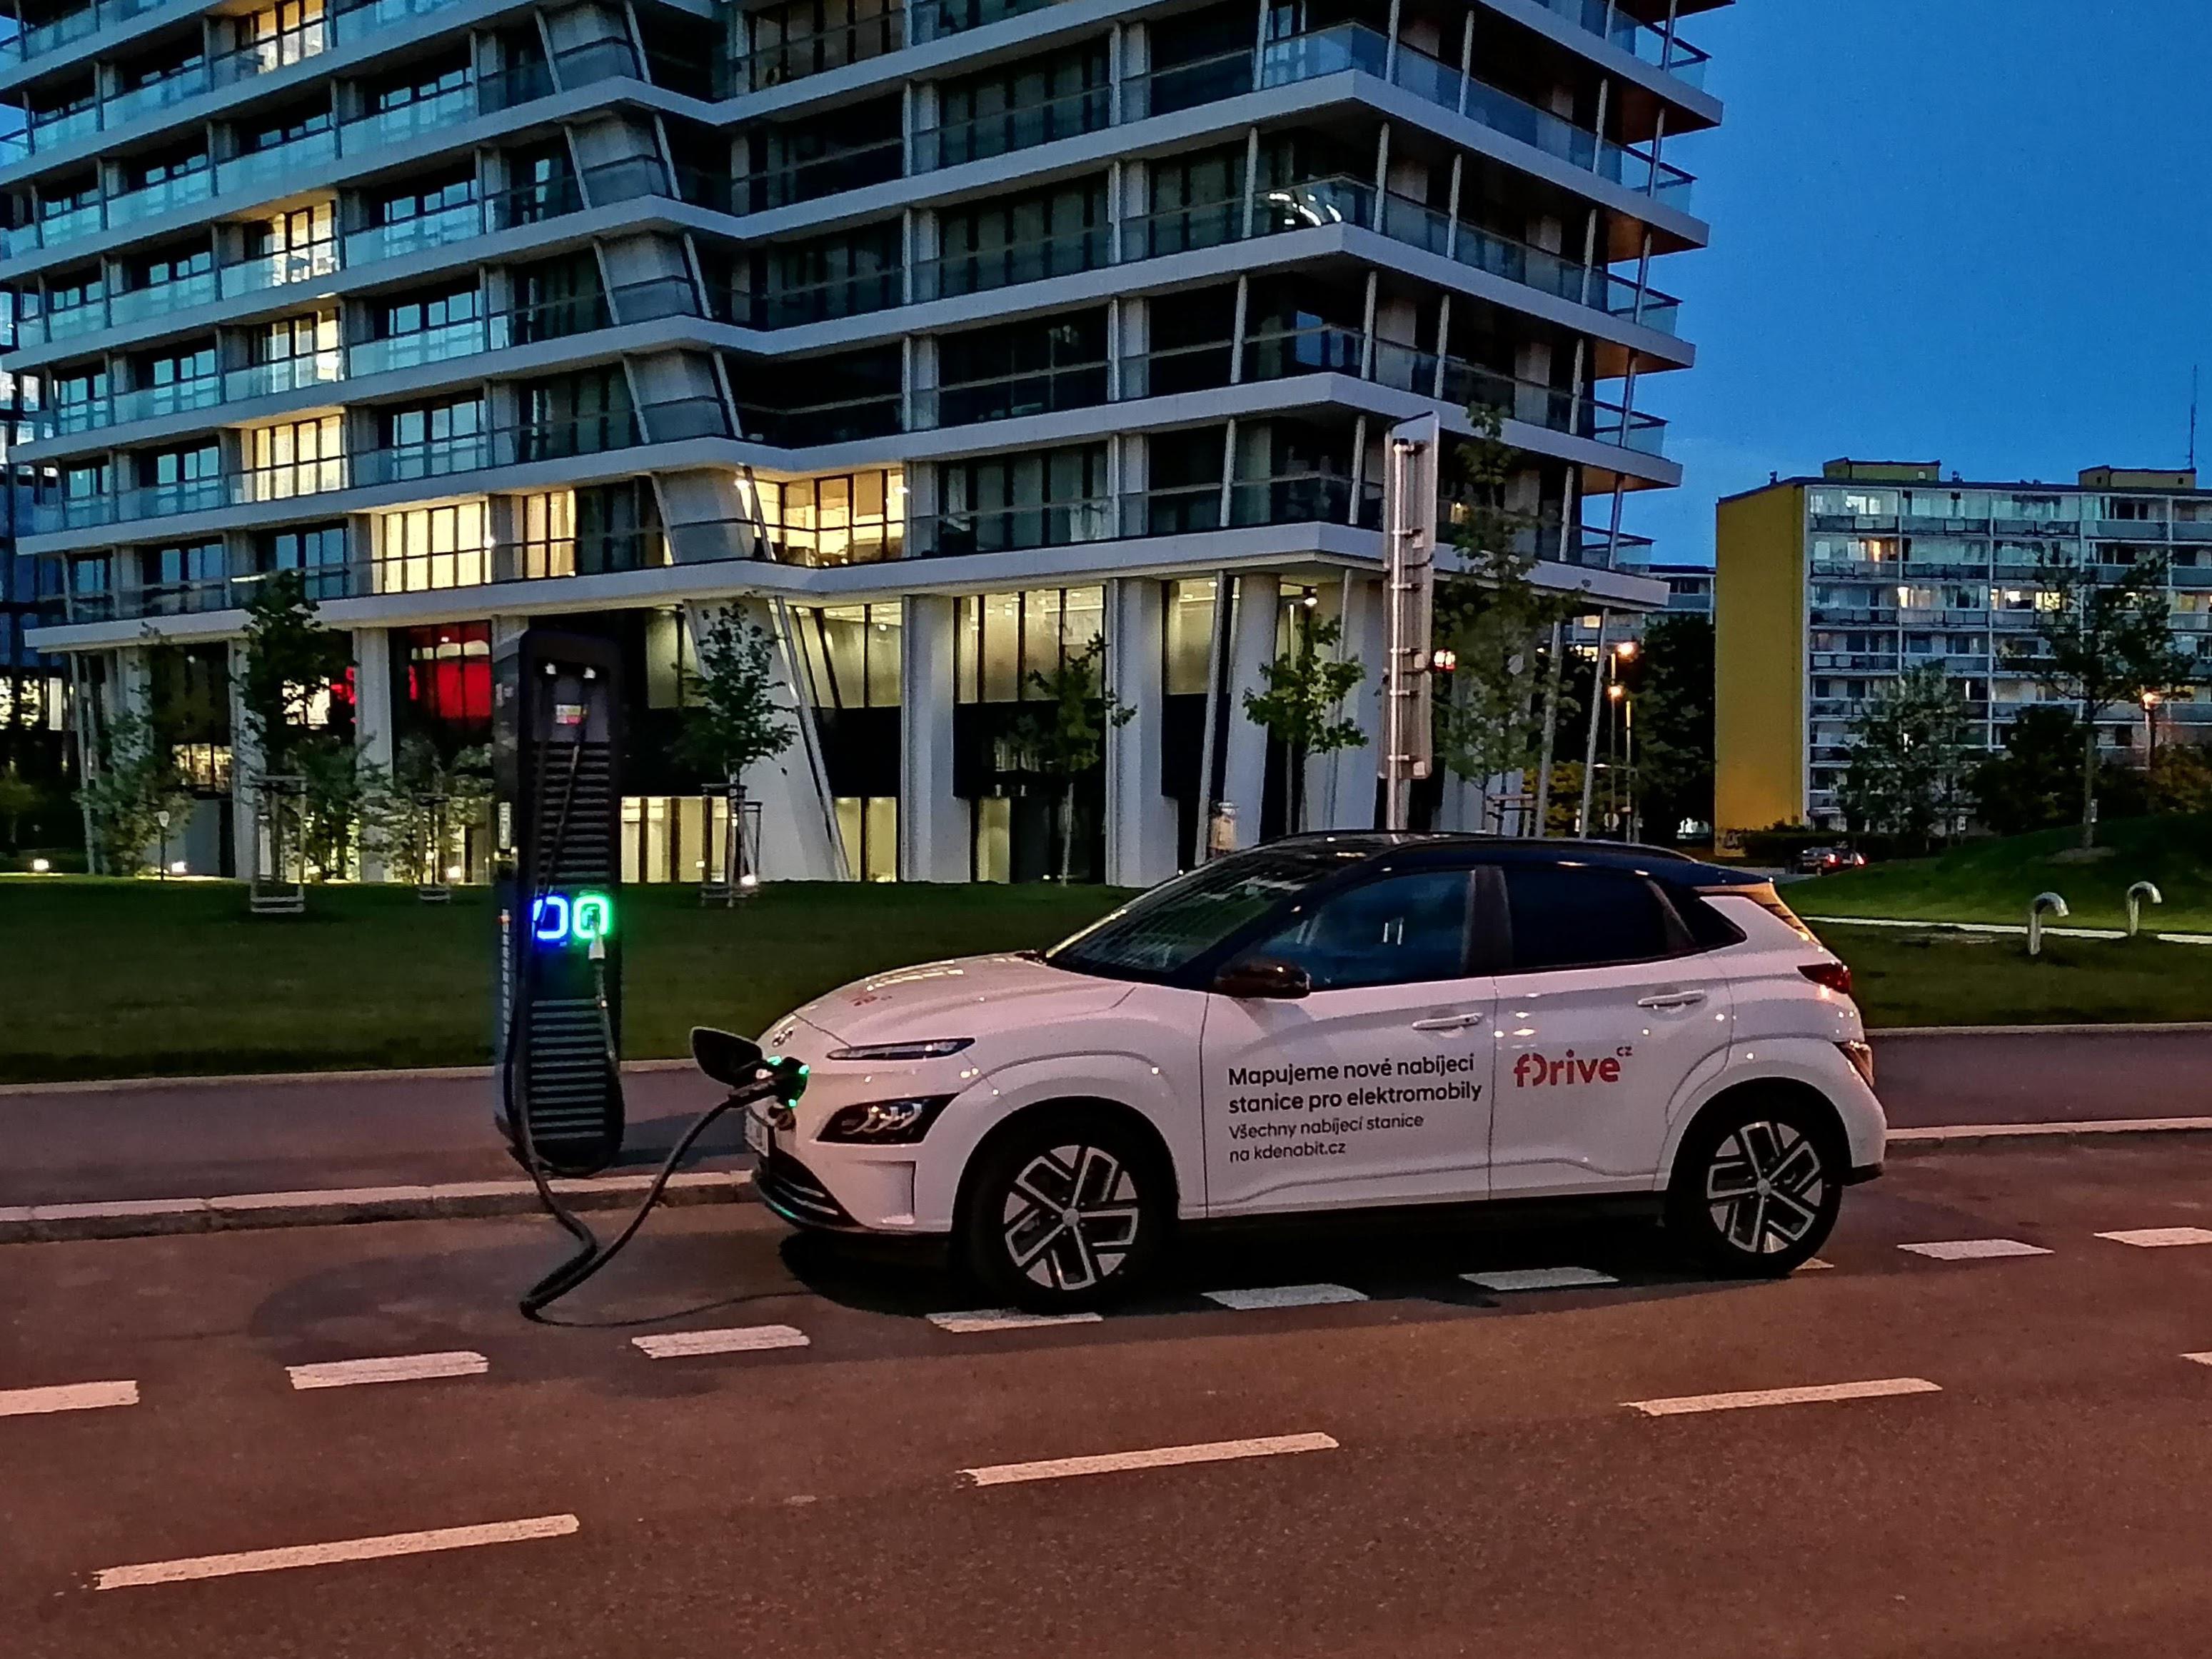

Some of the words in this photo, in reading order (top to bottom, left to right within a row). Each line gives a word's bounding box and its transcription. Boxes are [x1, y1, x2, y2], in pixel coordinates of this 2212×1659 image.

[1228, 1063, 1339, 1087] Mapujeme
[1344, 1058, 1392, 1079] nové
[1228, 1093, 1303, 1114] stanice
[1308, 1093, 1342, 1112] pro
[1347, 1081, 1482, 1106] elektromobily
[1229, 1123, 1297, 1140] Všechny
[1367, 1113, 1424, 1131] stanice
[1230, 1150, 1250, 1163] na
[1254, 1141, 1347, 1161] kdenabit.cz
